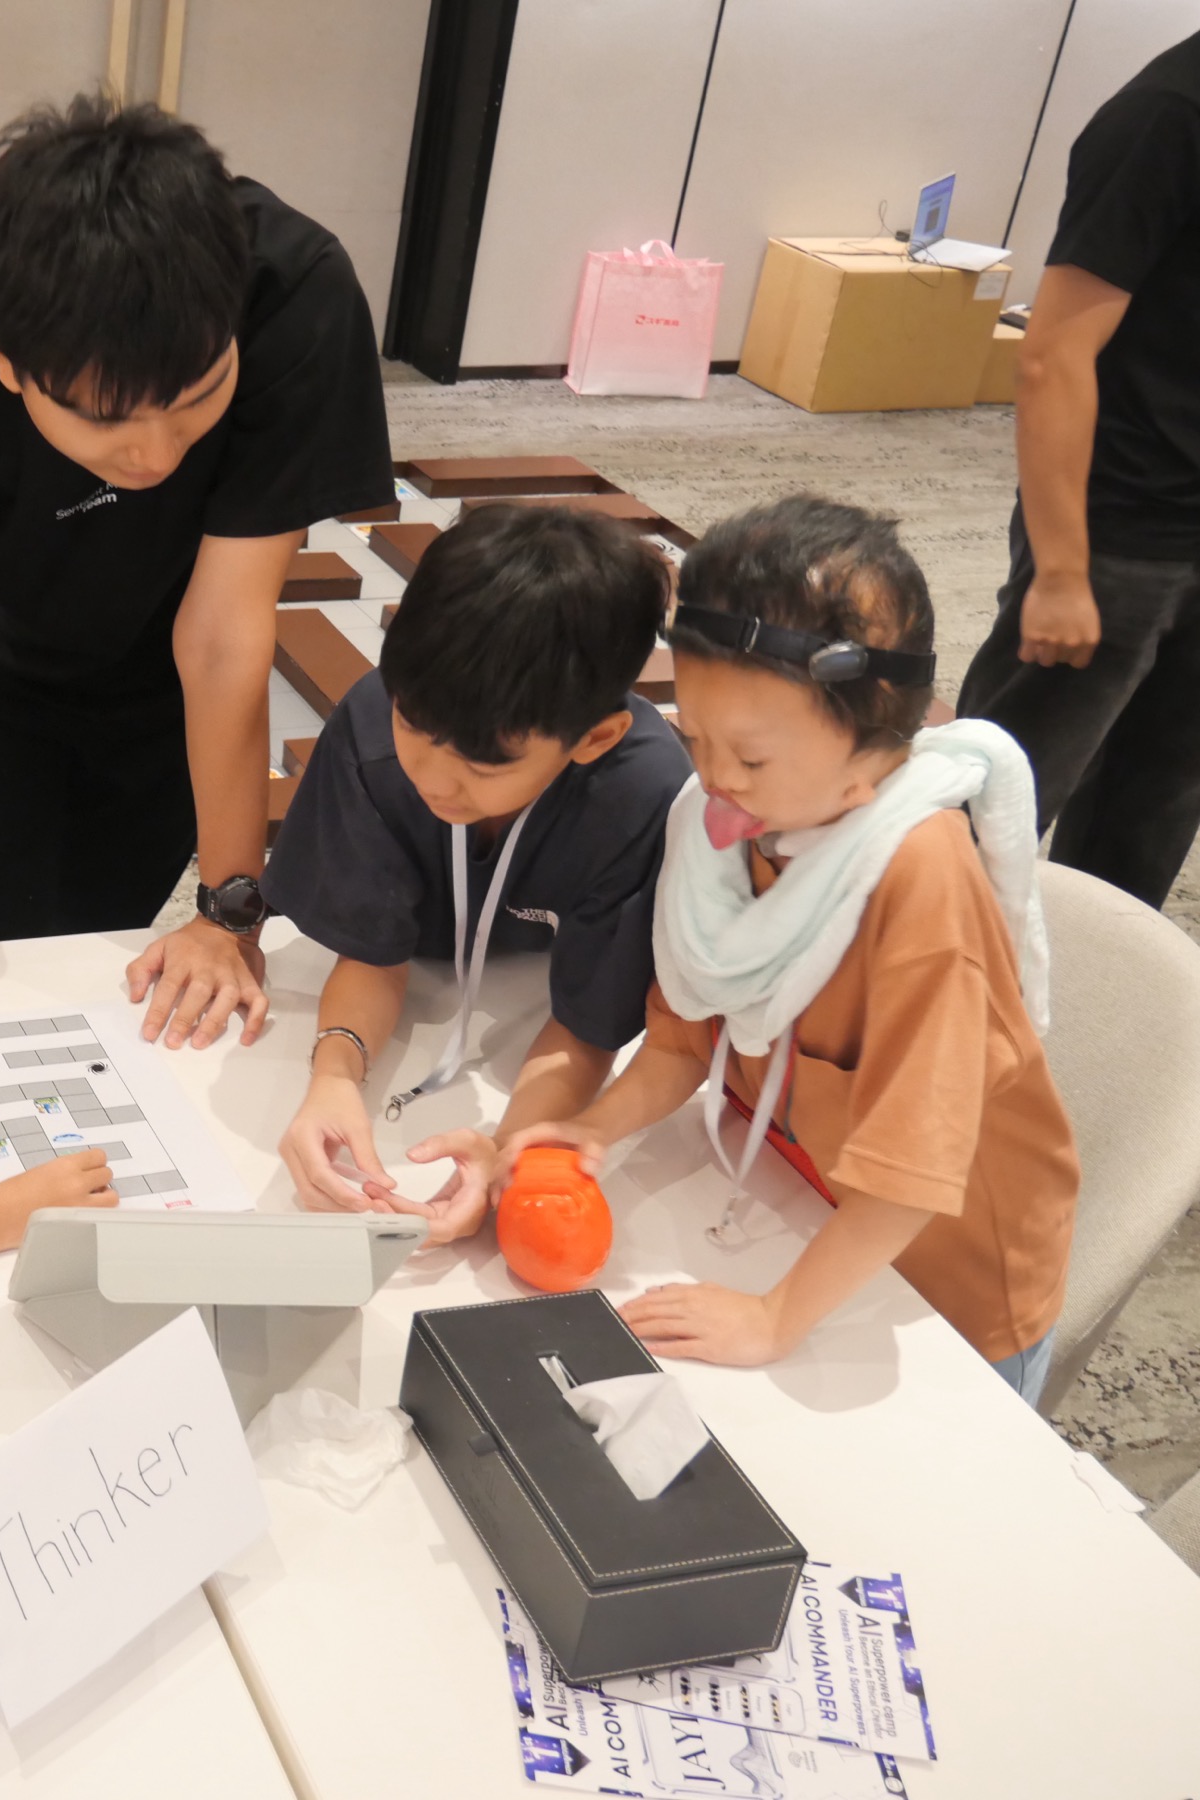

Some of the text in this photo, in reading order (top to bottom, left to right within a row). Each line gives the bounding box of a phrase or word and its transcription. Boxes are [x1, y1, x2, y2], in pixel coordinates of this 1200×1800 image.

[800, 1573, 818, 1592] AI
[838, 1609, 854, 1643] Unleash
[802, 1595, 839, 1723] COMMANDER
[844, 1644, 855, 1665] Your
[850, 1677, 866, 1736] Superpowers
[871, 1638, 891, 1704] Superpower
[883, 1705, 897, 1738] camp
[572, 1697, 589, 1737] Unleash
[610, 1756, 632, 1779] AI
